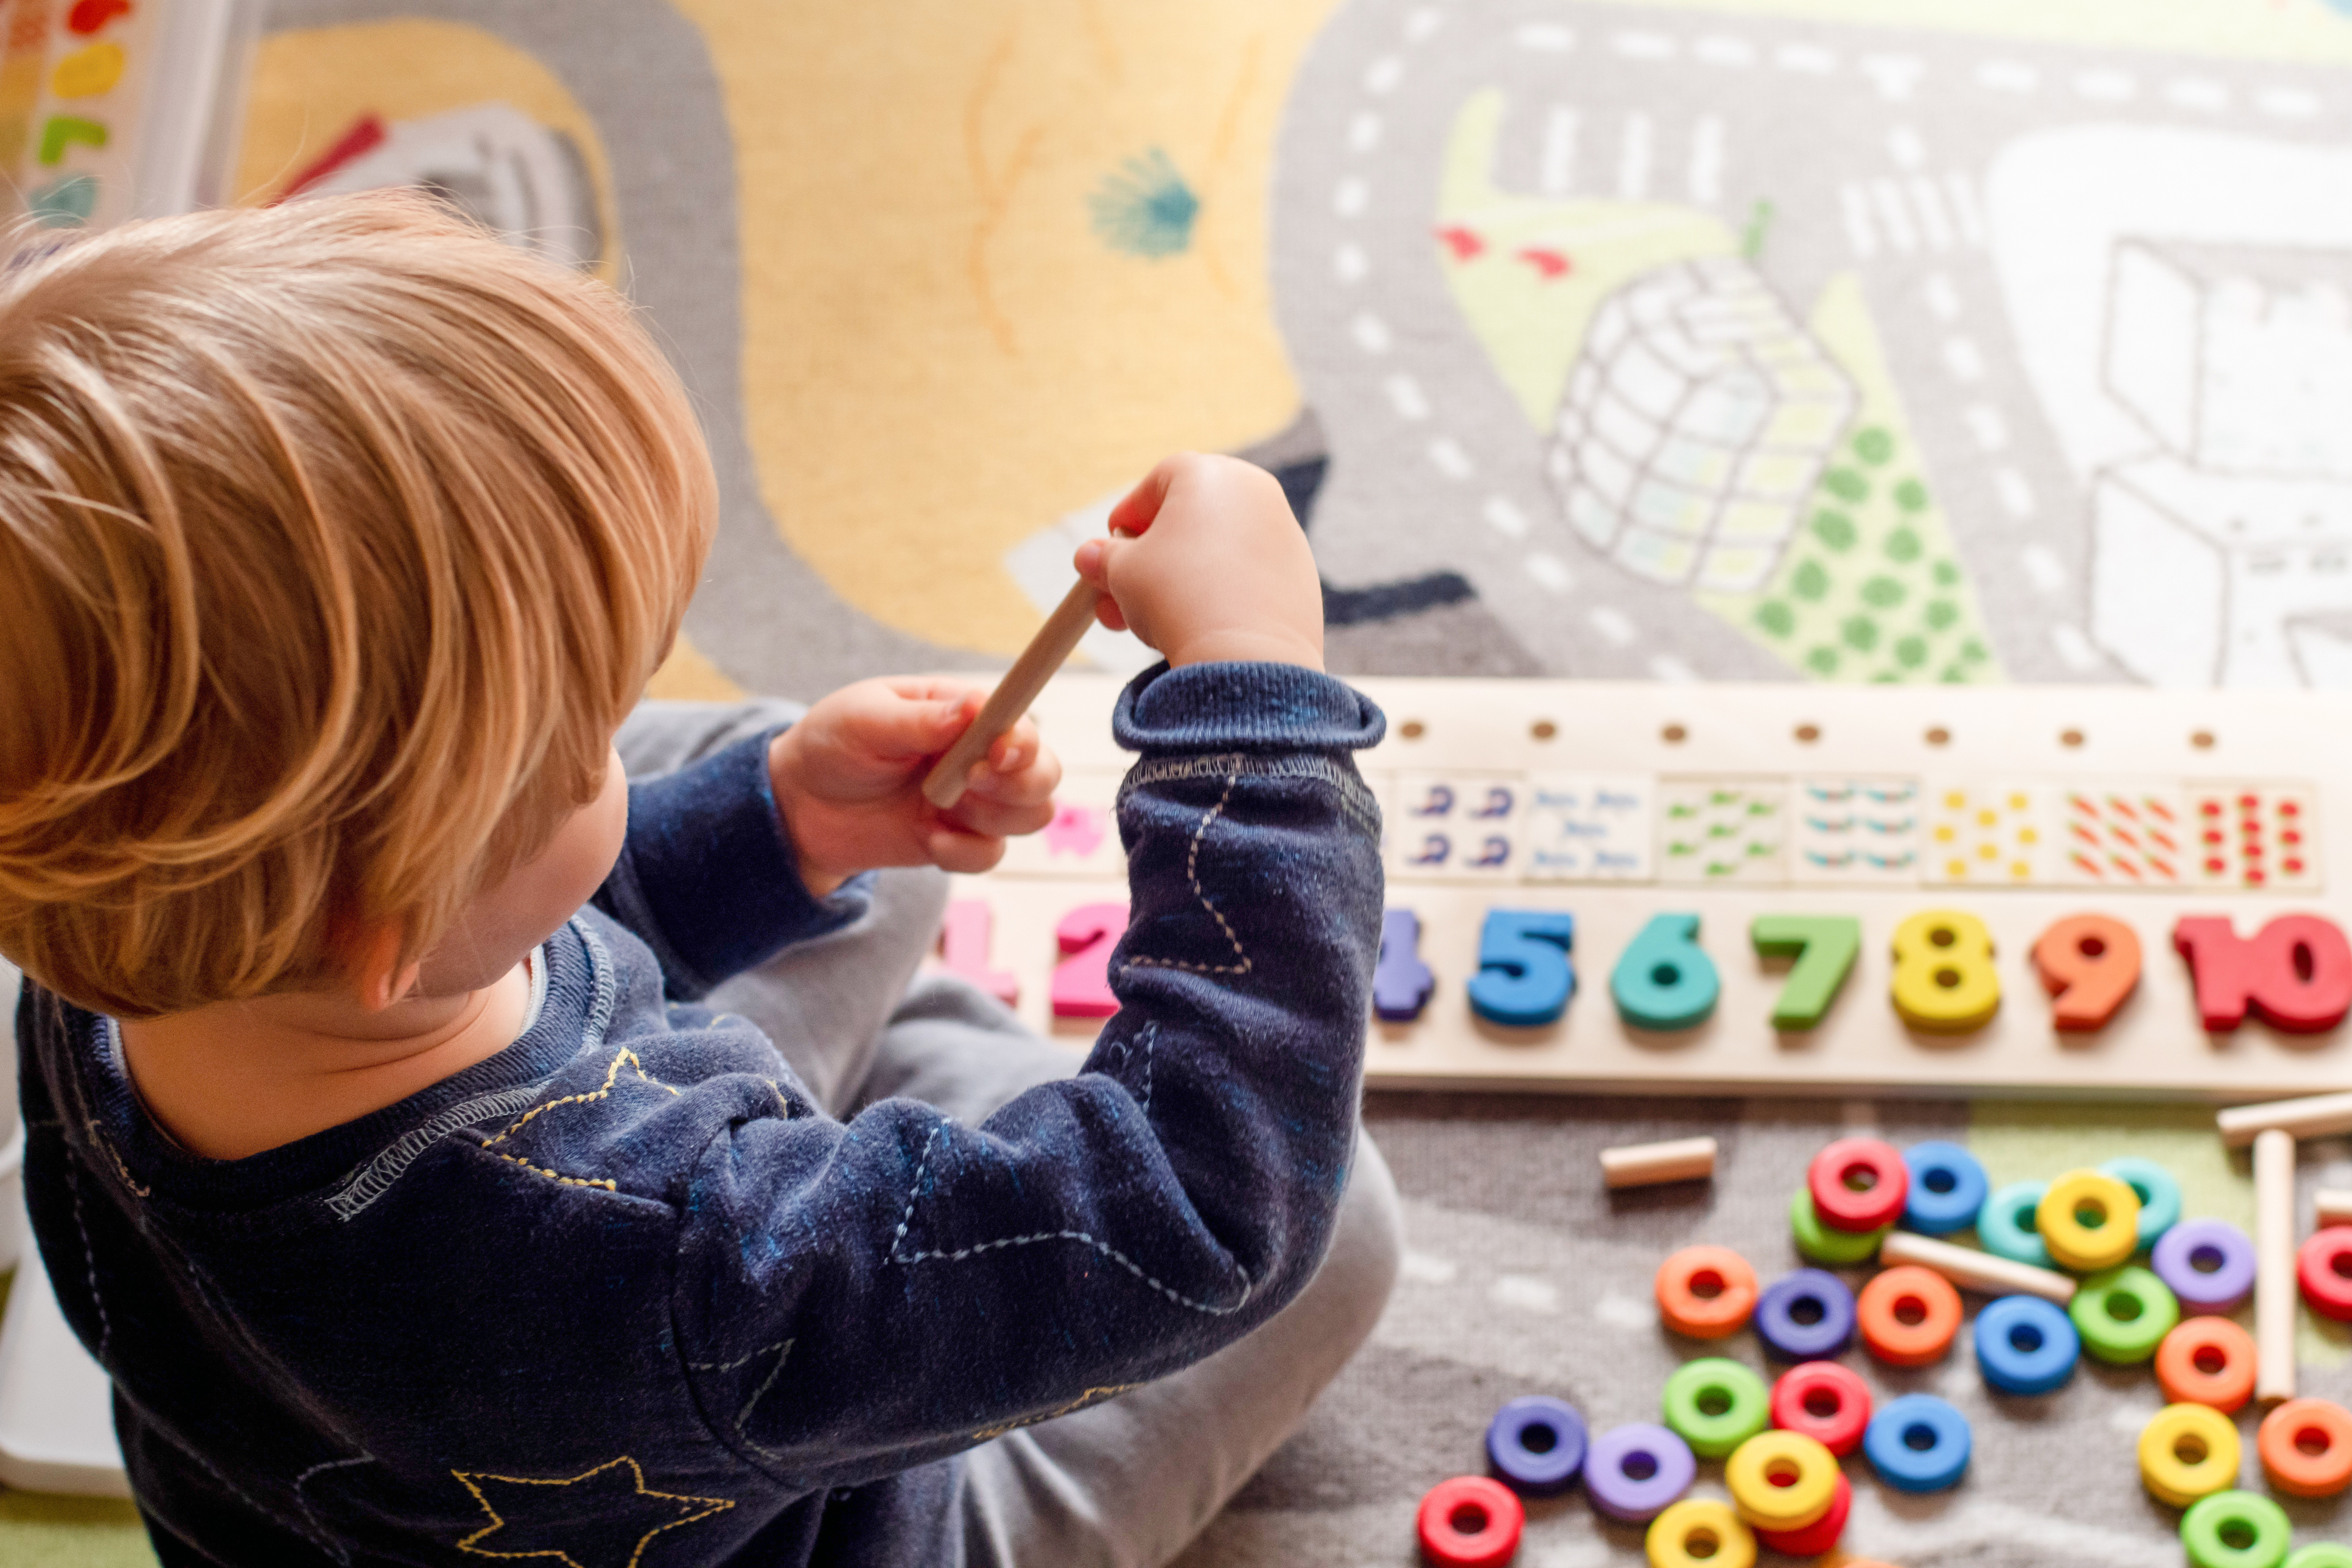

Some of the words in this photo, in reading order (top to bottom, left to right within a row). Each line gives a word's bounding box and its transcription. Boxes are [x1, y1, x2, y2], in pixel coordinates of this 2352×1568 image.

[39, 114, 107, 167] 7
[941, 899, 1018, 1008] 1
[1051, 903, 1131, 1018] 2
[1467, 909, 1576, 1026] 5
[1610, 912, 1720, 1030] 6
[1751, 915, 1861, 1030] 7
[1890, 909, 2001, 1034] 8
[2030, 912, 2143, 1032] 9
[2172, 913, 2352, 1034] 10
